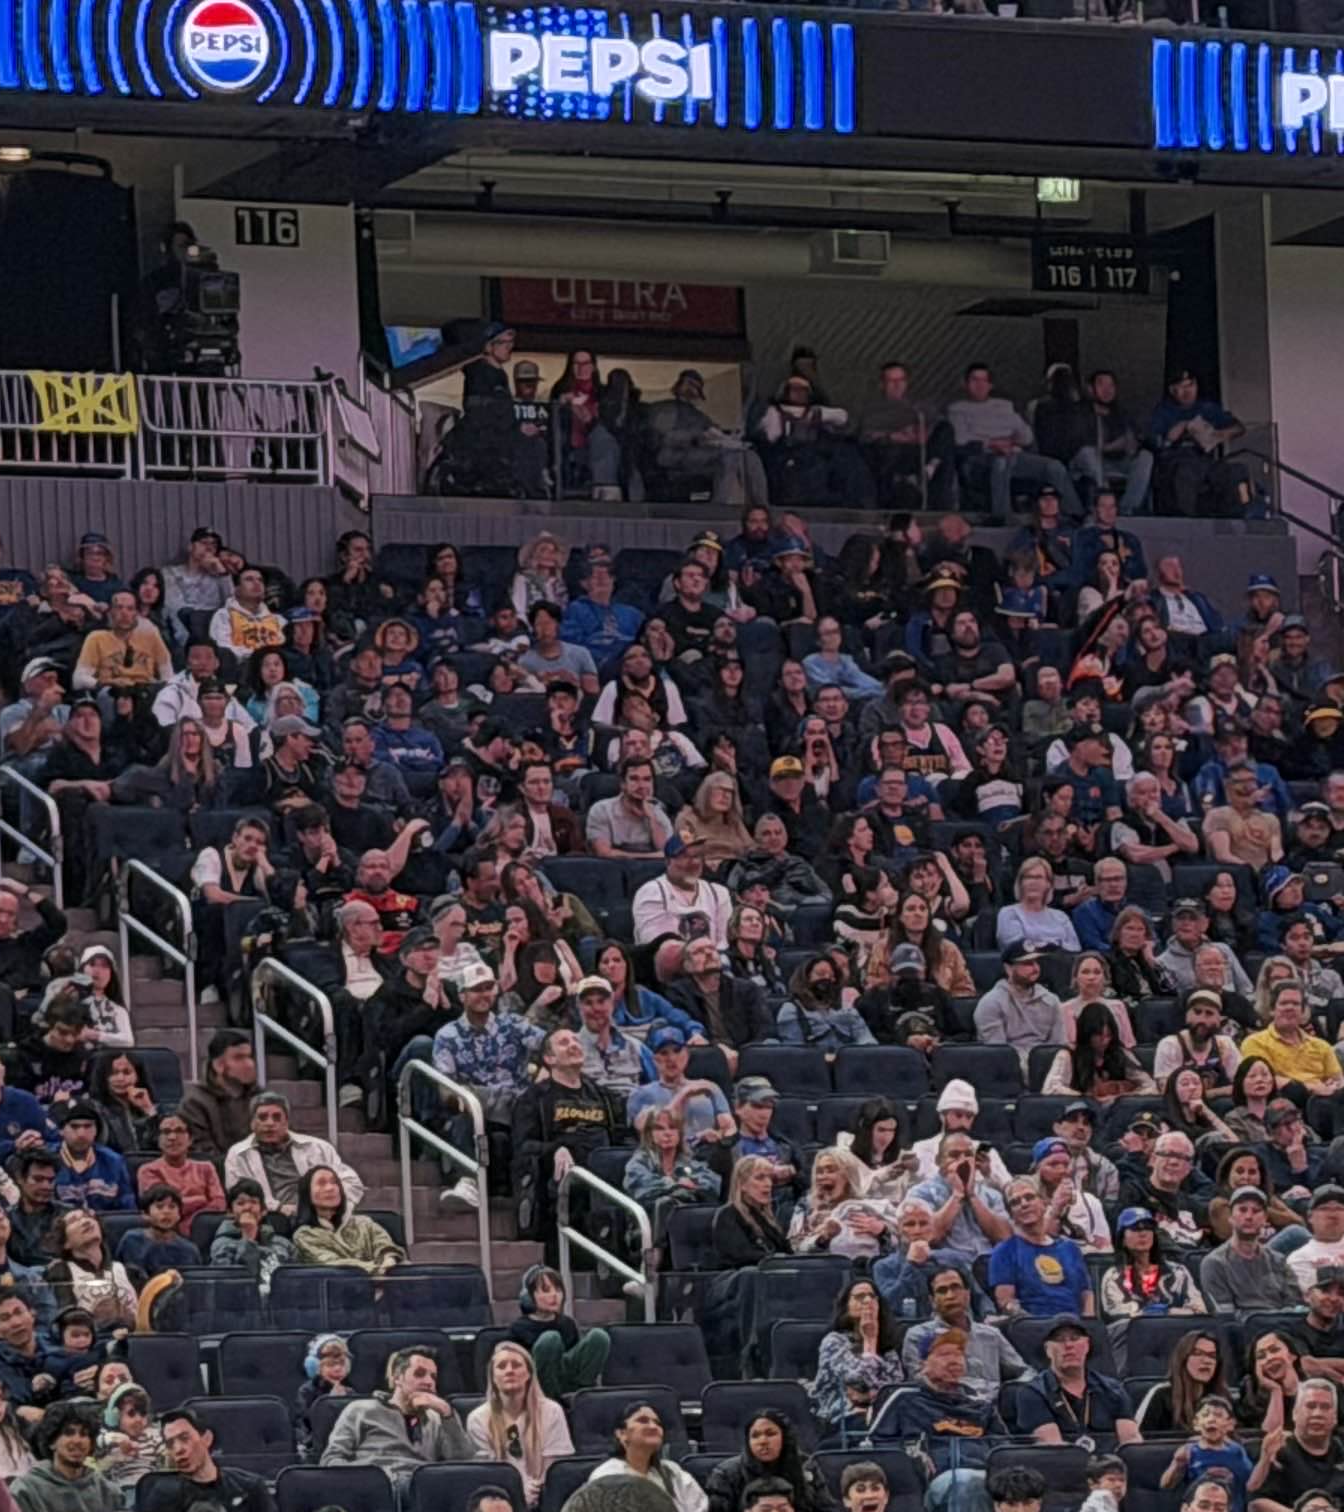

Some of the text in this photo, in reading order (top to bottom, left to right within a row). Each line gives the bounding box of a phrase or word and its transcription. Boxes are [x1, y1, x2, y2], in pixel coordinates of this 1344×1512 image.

[190, 31, 261, 54] PEPSI
[489, 31, 713, 100] PEPSI
[238, 211, 297, 245] 116
[1048, 265, 1137, 289] 116 117
